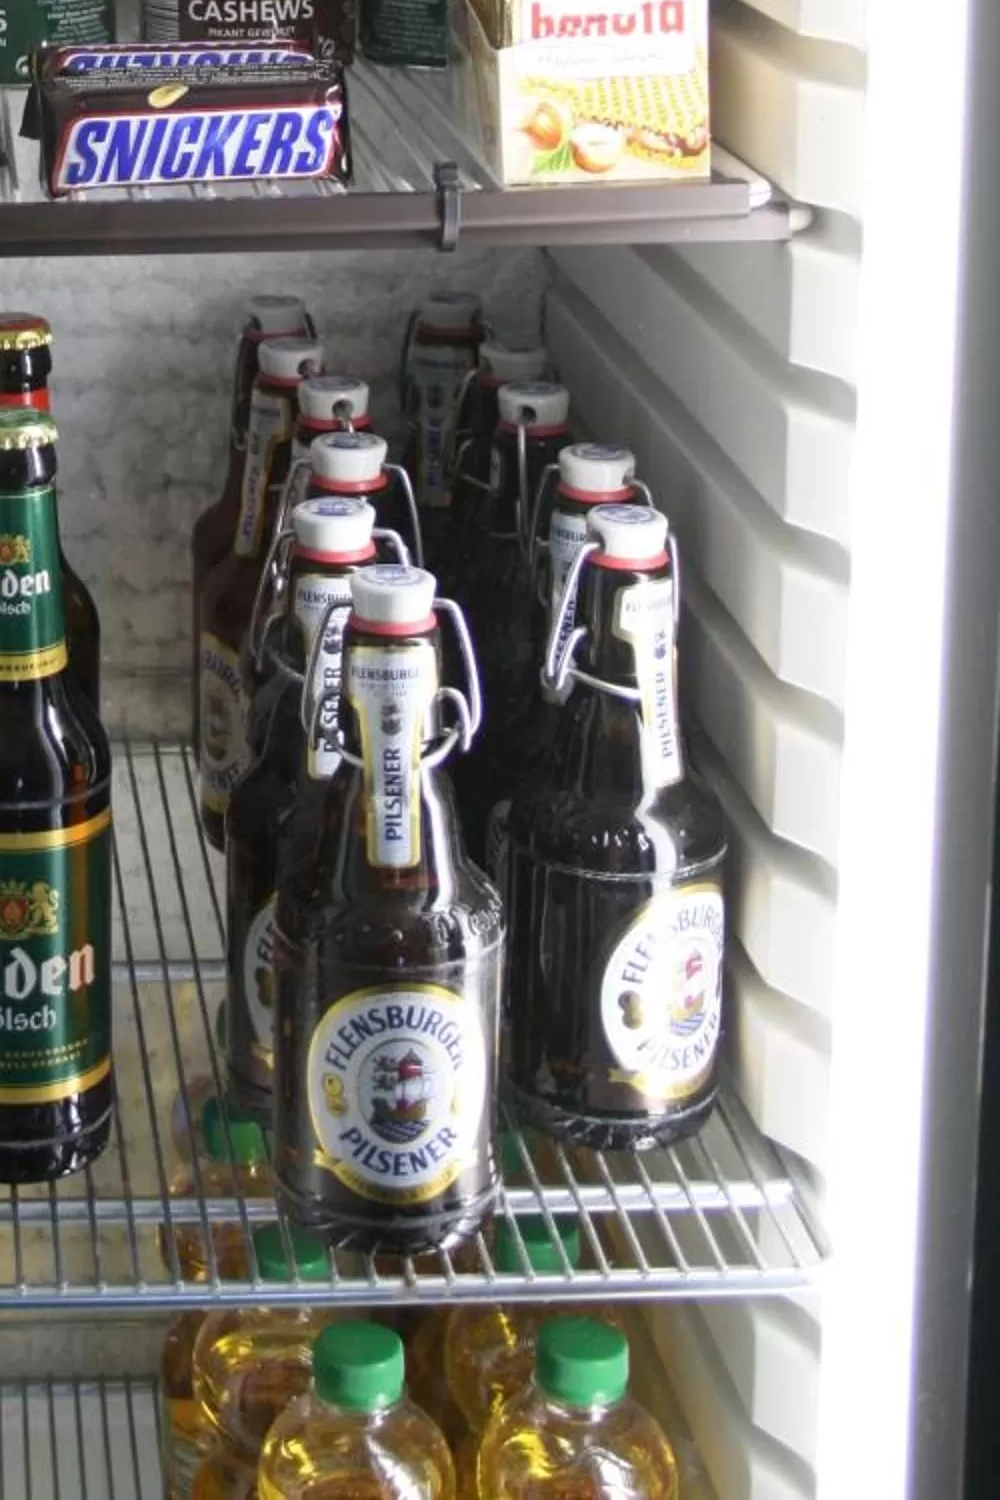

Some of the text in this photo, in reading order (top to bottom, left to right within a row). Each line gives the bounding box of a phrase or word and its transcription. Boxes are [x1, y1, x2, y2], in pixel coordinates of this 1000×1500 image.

[67, 107, 332, 188] SNICKERS
[384, 747, 404, 842] PILSENER
[338, 1126, 459, 1177] PILSENER
